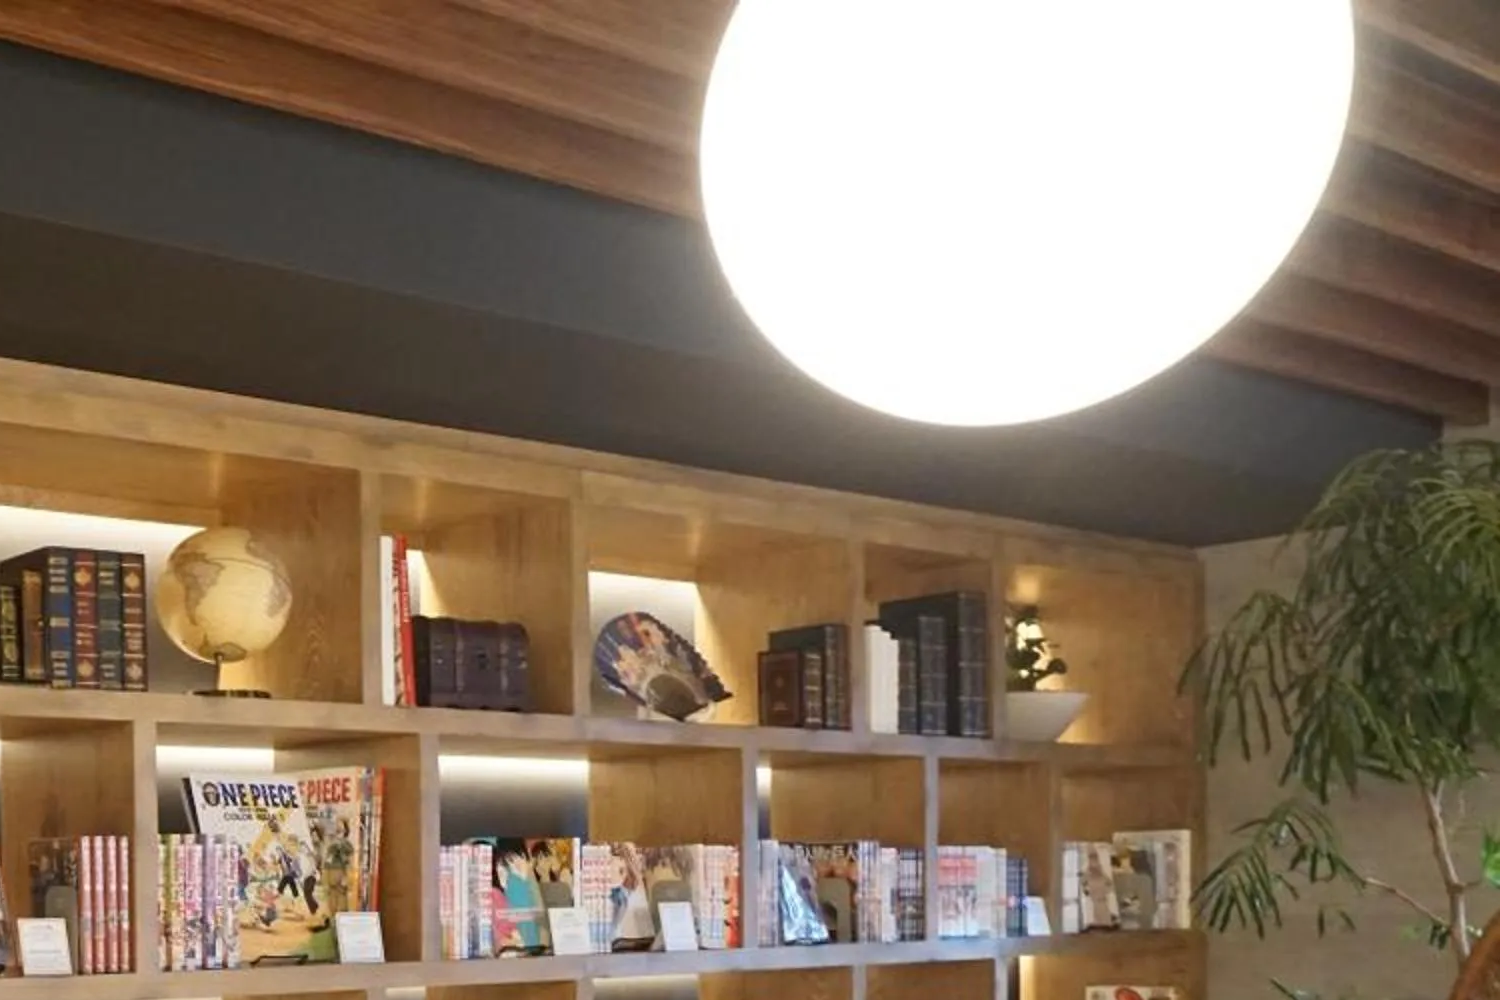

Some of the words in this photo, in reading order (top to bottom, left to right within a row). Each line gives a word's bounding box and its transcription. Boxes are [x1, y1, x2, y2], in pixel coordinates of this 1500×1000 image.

[202, 781, 247, 807] ONE
[250, 783, 299, 809] PIECE
[306, 777, 350, 803] PIECE
